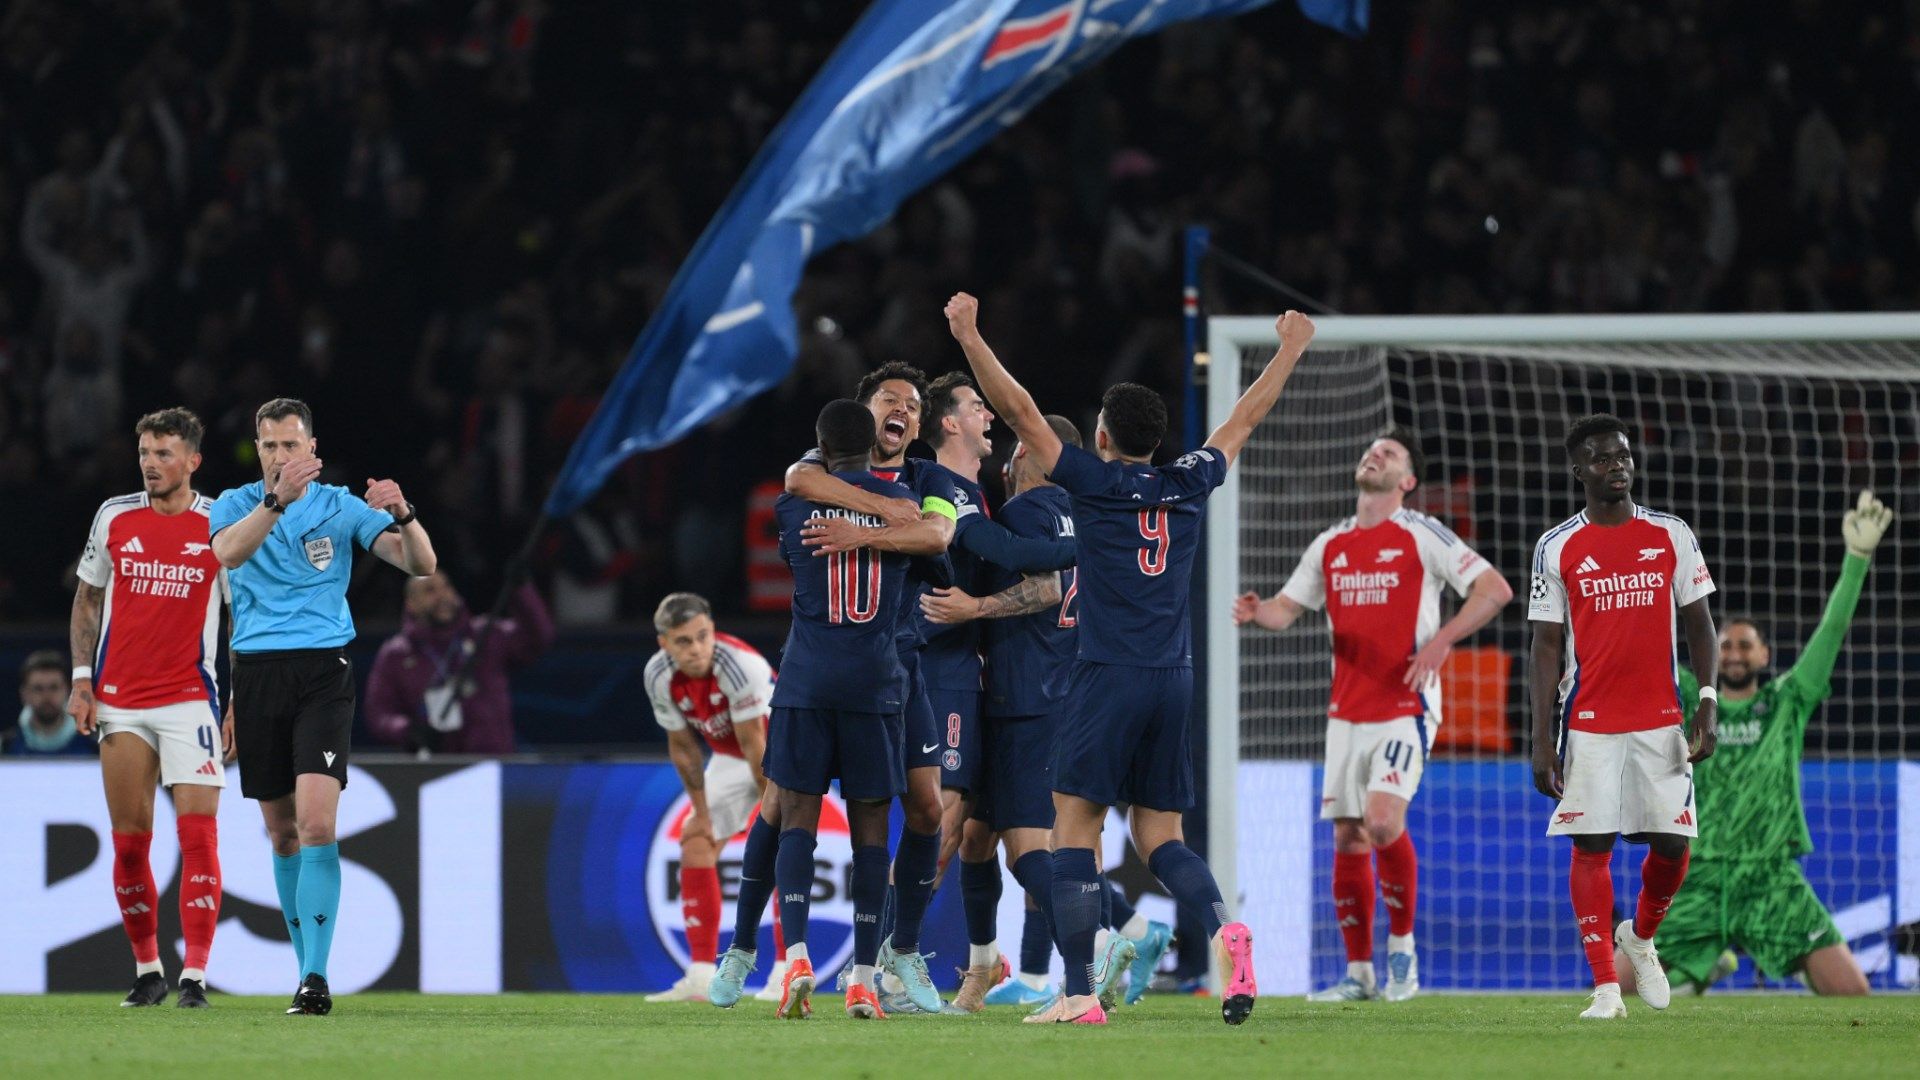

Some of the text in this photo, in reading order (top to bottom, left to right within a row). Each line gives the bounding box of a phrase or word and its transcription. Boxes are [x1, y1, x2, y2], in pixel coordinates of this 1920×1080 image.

[1138, 506, 1170, 576] 9
[120, 557, 205, 584] Emirates
[131, 579, 191, 599] FLY BETTER
[828, 546, 882, 624] 10
[1331, 571, 1400, 592] Emirates
[1578, 570, 1664, 598] Emirates
[1356, 590, 1388, 605] BETTER
[1595, 590, 1655, 612] FLY BETTER
[947, 713, 961, 748] 8
[195, 725, 216, 758] 4
[1384, 739, 1414, 773] 41
[116, 884, 146, 896] AFC
[189, 874, 217, 886] AFC
[785, 893, 805, 904] PARIS
[855, 912, 877, 924] PARIS
[1579, 915, 1598, 925] AFC
